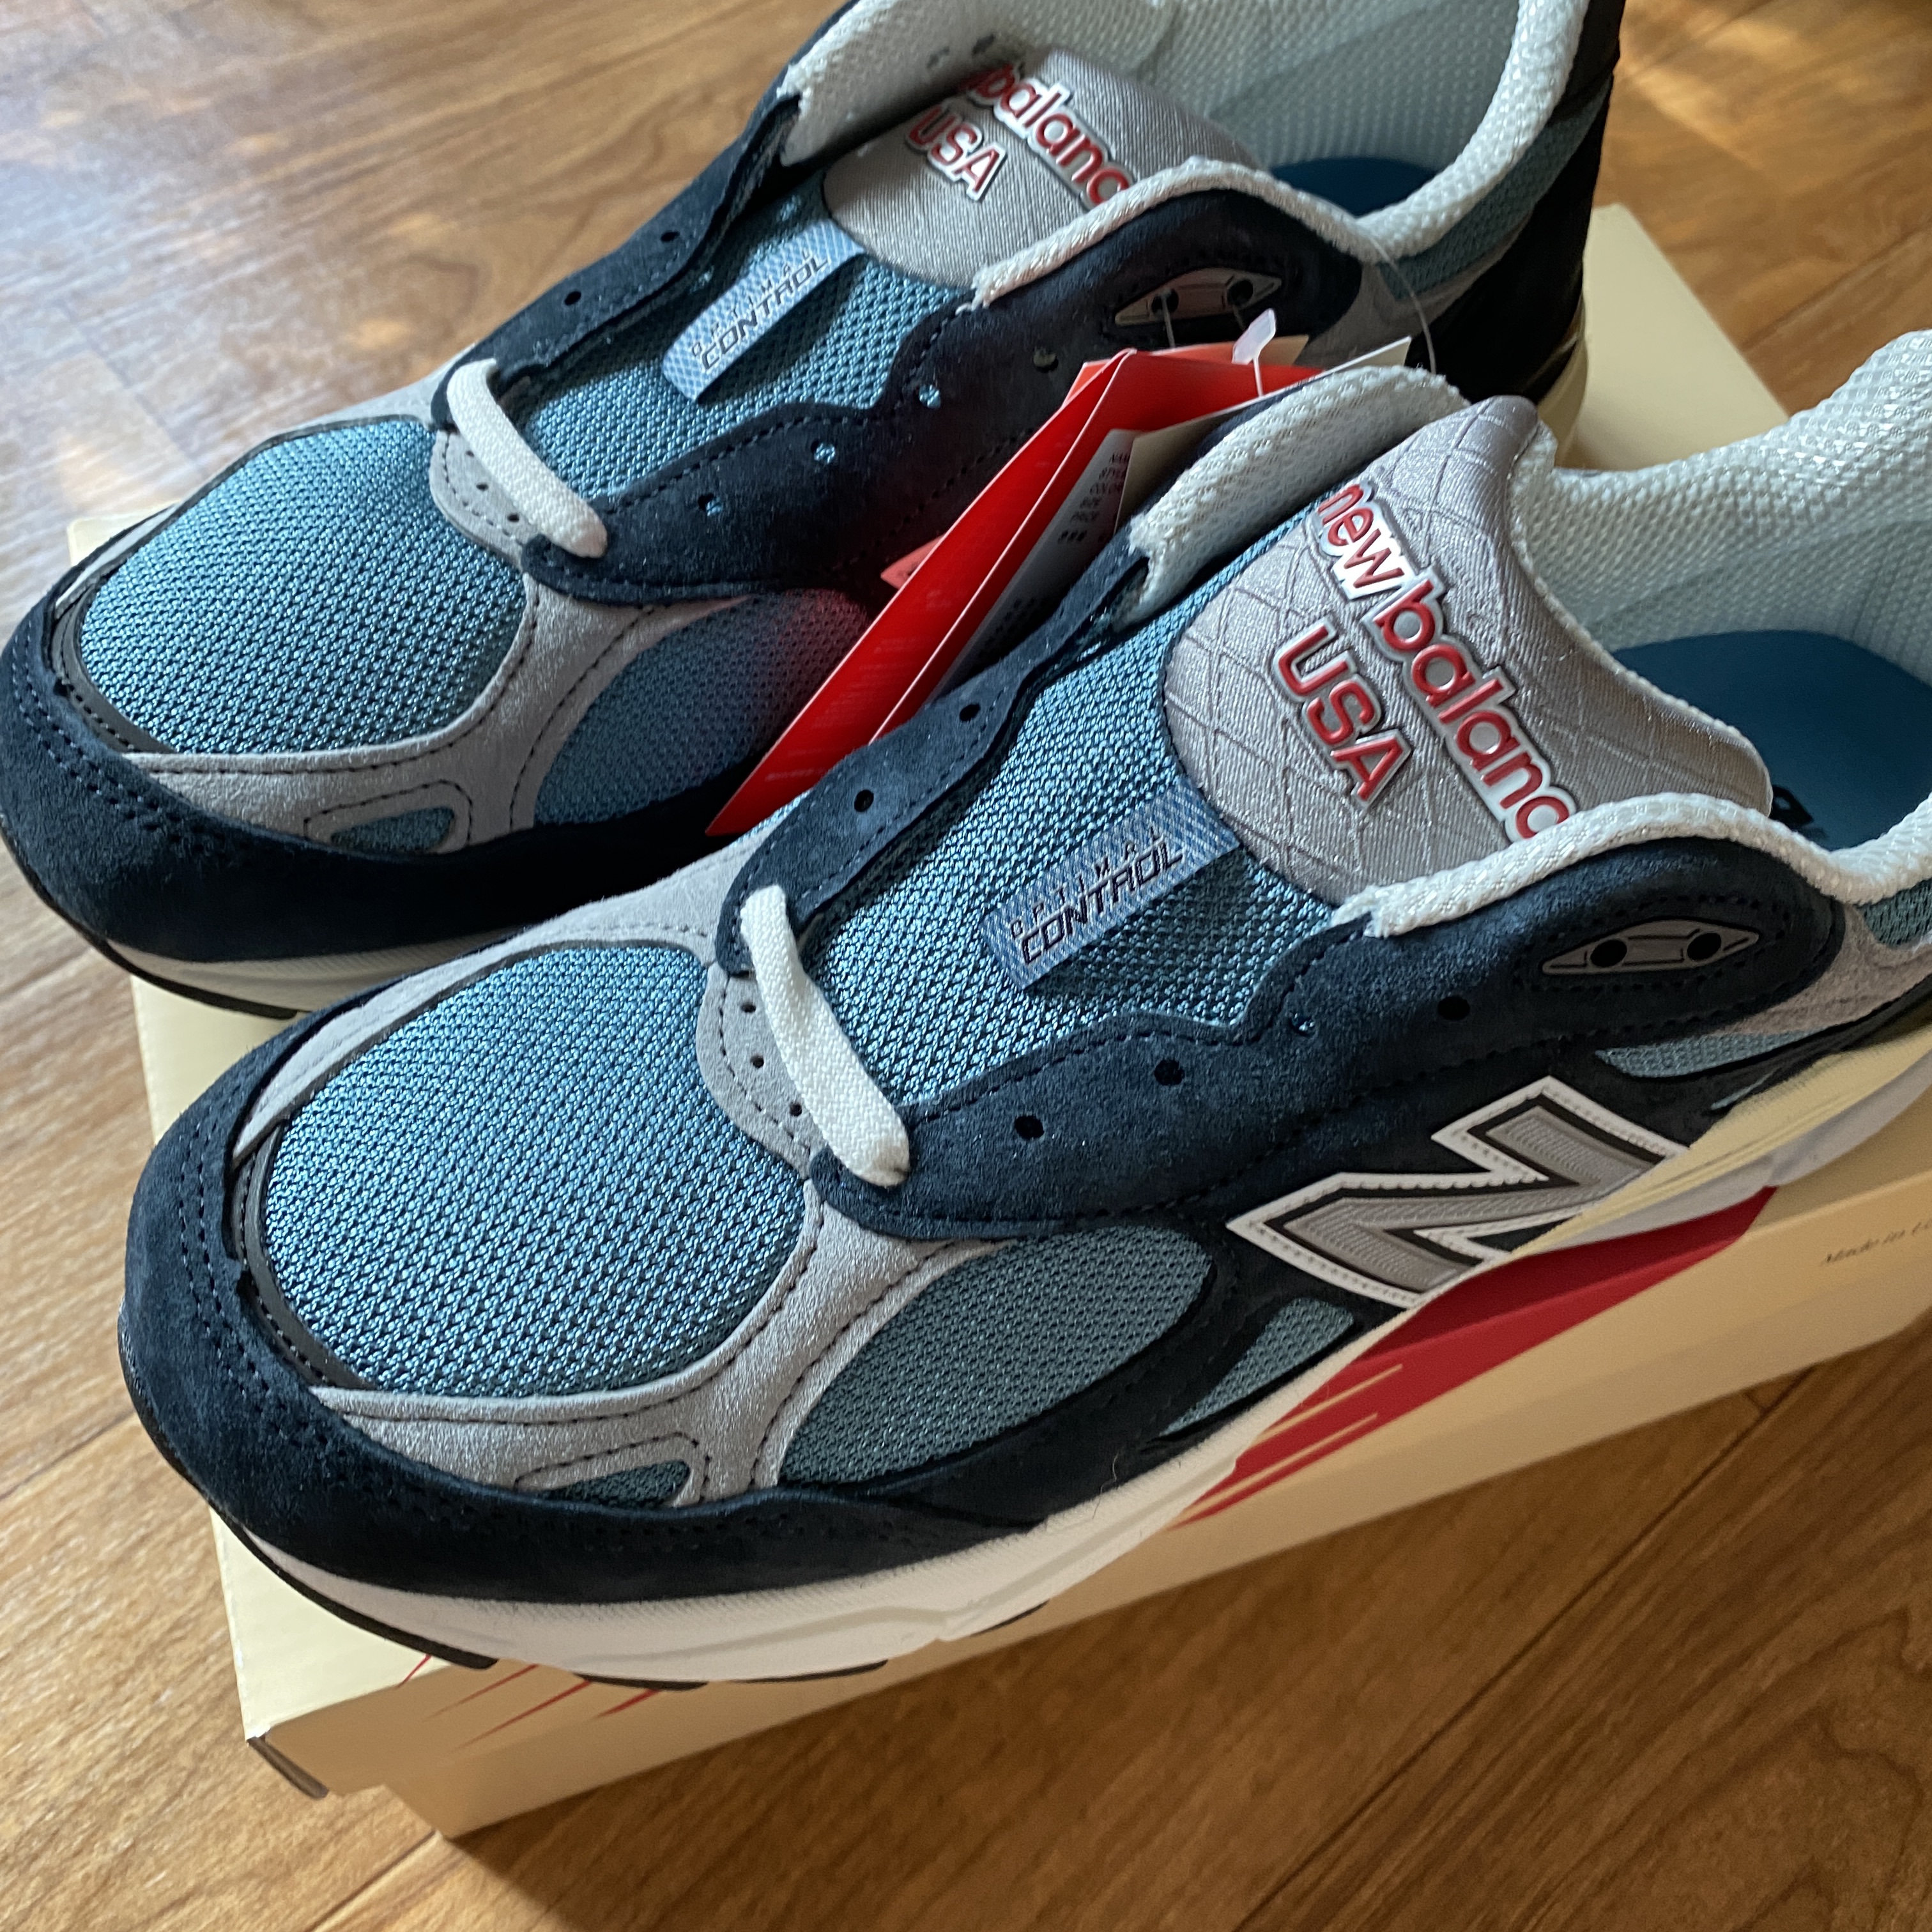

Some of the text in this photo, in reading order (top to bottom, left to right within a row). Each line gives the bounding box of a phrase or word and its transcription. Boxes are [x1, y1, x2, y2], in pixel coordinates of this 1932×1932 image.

[907, 107, 1000, 193] USA
[958, 64, 1130, 206] balanc
[702, 255, 829, 371] CONTROL
[1276, 625, 1404, 801] USA
[1317, 484, 1570, 839] new balanc
[1022, 838, 1184, 965] CONTROL
